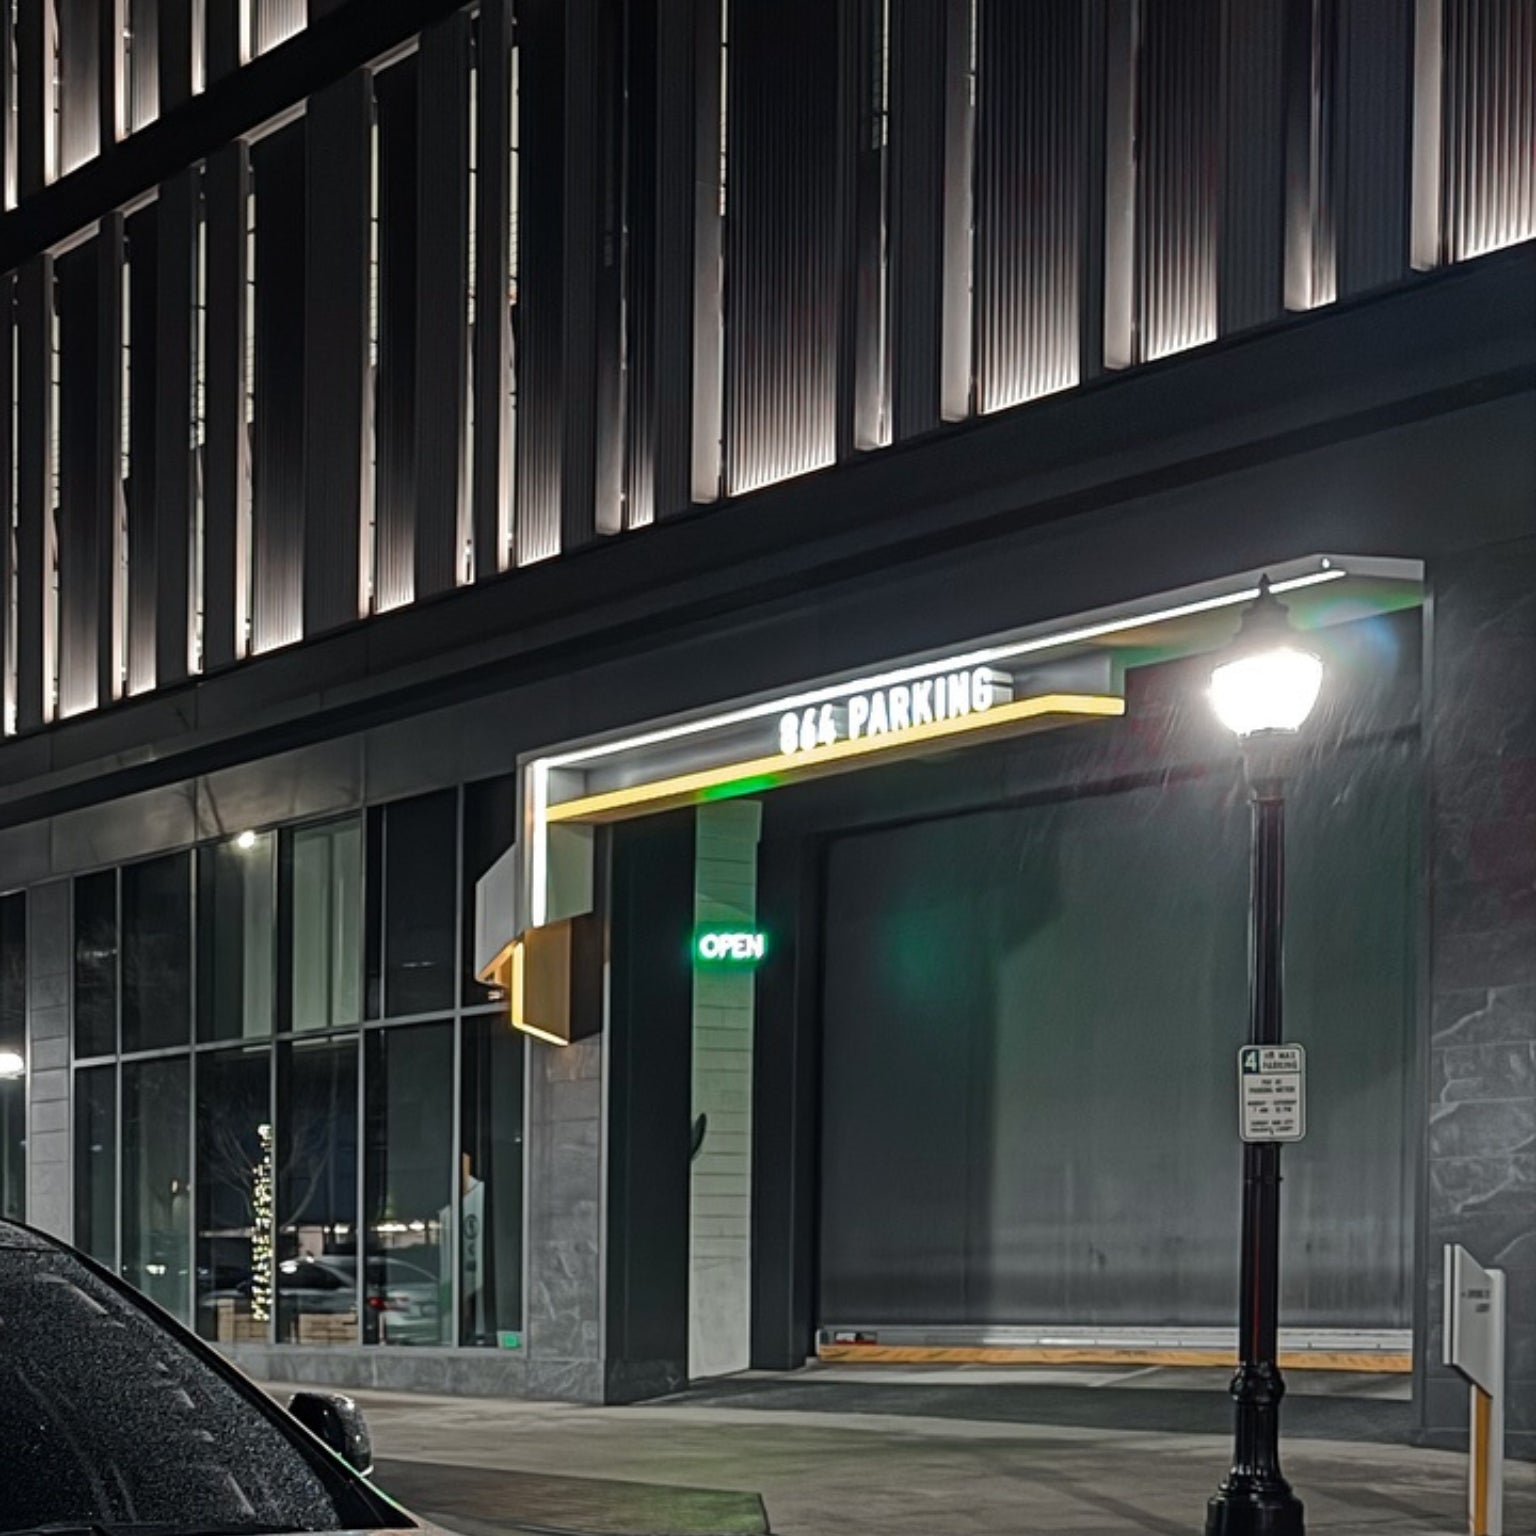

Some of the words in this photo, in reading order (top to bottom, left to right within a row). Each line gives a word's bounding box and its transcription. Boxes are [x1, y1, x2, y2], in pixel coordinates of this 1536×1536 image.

[848, 667, 993, 740] PARKING
[699, 933, 763, 959] OPEN
[1245, 1051, 1257, 1071] 4
